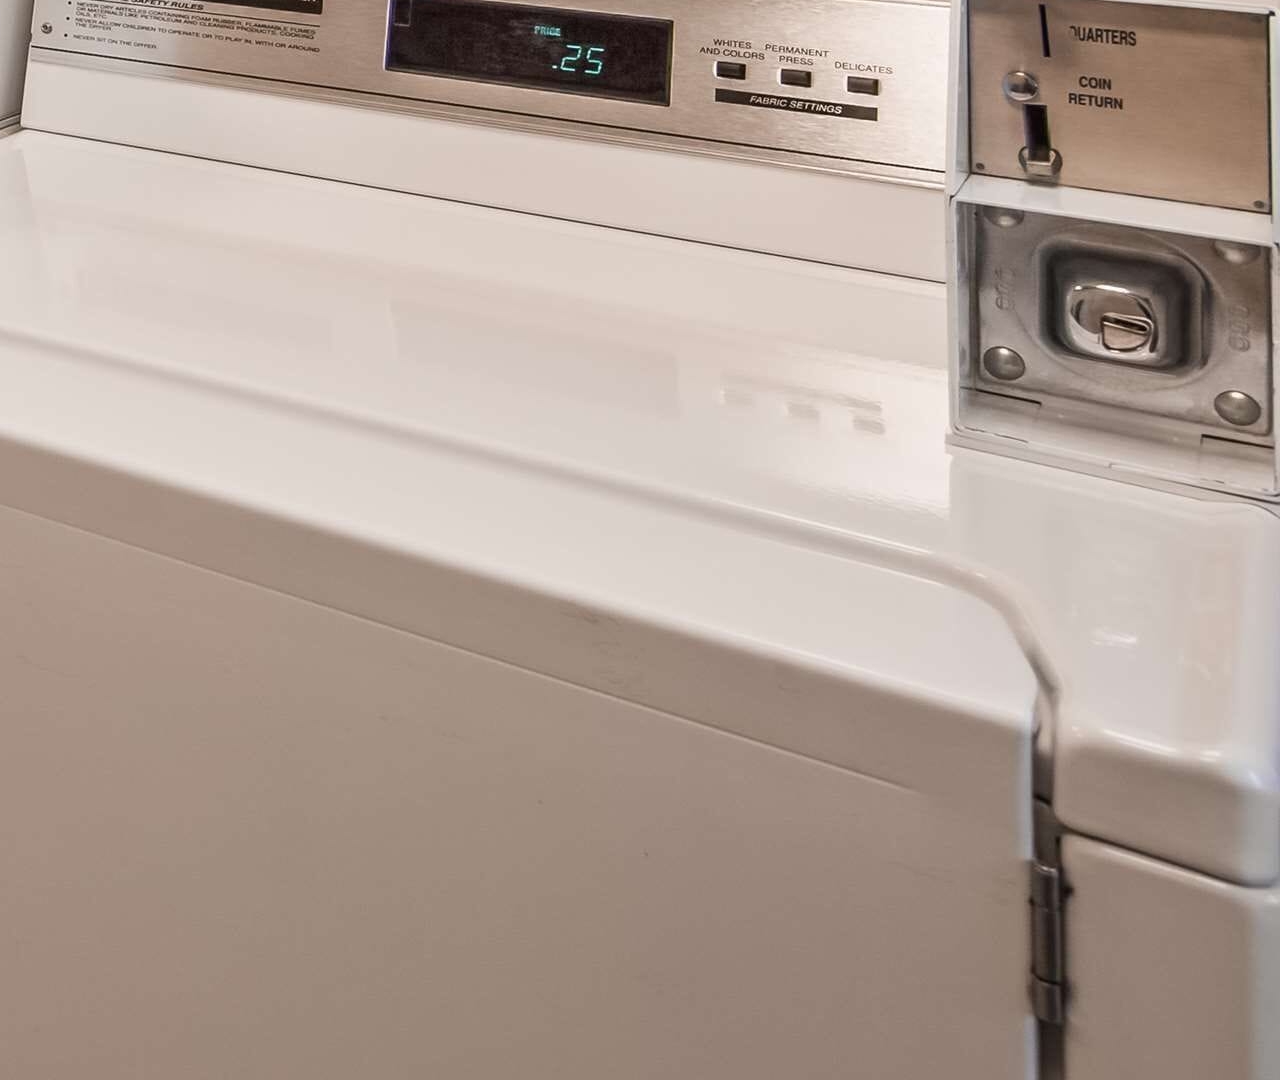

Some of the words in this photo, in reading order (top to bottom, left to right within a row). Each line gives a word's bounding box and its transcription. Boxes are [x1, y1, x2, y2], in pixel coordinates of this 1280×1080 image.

[170, 1, 204, 11] RULES
[534, 25, 561, 37] PRICE
[712, 38, 752, 50] WHITES
[764, 43, 830, 58] PERMANENT
[551, 44, 605, 75] .25
[699, 46, 722, 56] AND
[722, 48, 766, 62] COLORS
[778, 55, 815, 66] PRESS
[834, 60, 894, 75] DELICATES
[1078, 75, 1112, 91] COIN
[749, 94, 789, 108] FABRIC
[789, 99, 843, 115] SETTINGS
[1068, 92, 1124, 110] RETURN
